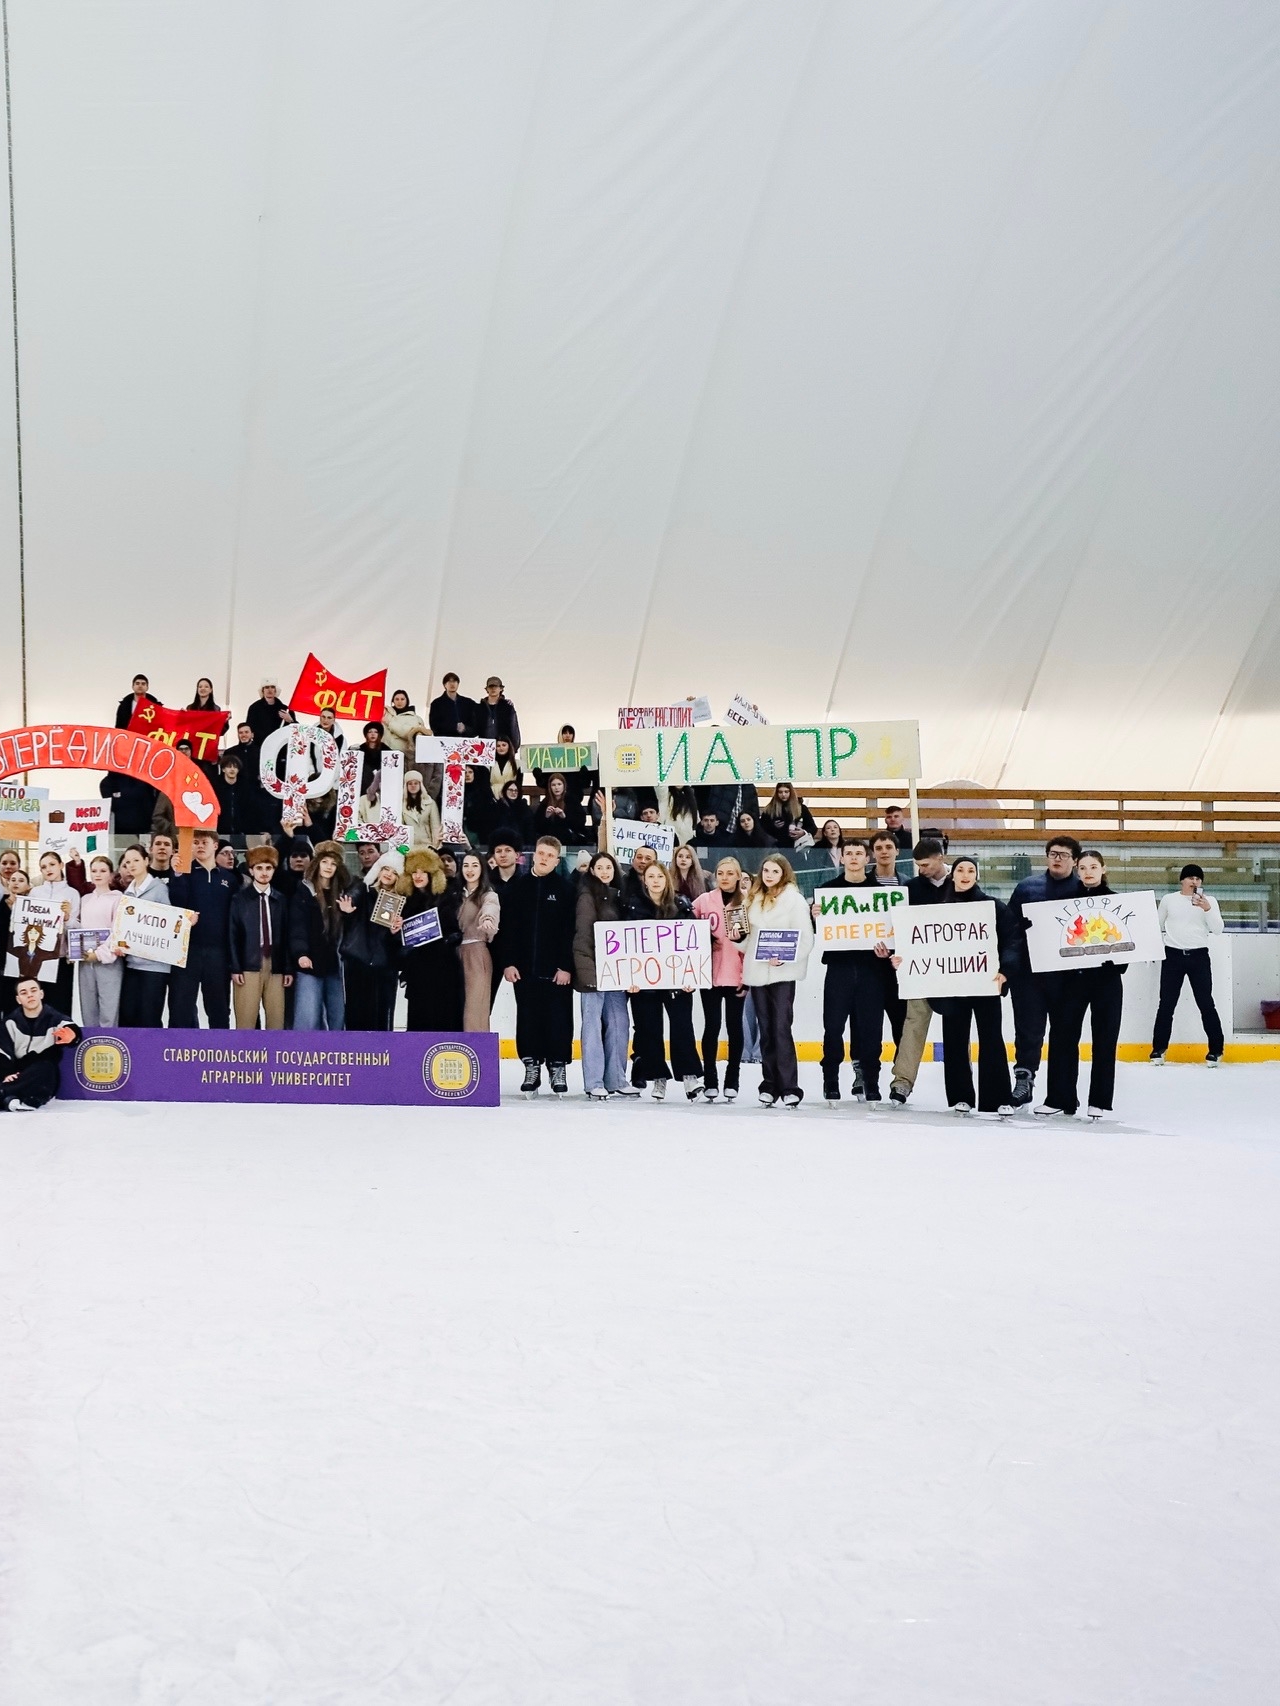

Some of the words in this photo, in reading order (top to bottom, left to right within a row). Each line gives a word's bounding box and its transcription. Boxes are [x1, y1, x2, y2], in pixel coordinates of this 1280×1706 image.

[313, 690, 383, 720] ФЦТ
[618, 707, 654, 717] АГРОФАК
[527, 746, 589, 769] ИАиПР
[656, 727, 859, 784] ИАиПР
[75, 806, 101, 818] ИСПО
[626, 831, 636, 840] НЕ
[638, 832, 668, 846] СКРОЕТ
[821, 891, 905, 916] ИАиПР
[1055, 897, 1136, 926] АГРОФАК
[21, 916, 29, 925] ЗА
[137, 913, 167, 929] ИСПО
[124, 930, 170, 950] ЛУЧШИЕ!
[605, 921, 699, 955] ВПЕРЁД
[911, 922, 989, 945] АГРОФАК
[600, 954, 711, 988] АГРОФАК
[909, 951, 988, 975] ЛУЧШИЙ
[163, 1047, 268, 1064] СТАВРОПОЛЬСКИЙ
[275, 1049, 391, 1067] ГОСУДАРСТВЕННЫЙ
[201, 1068, 263, 1085] АГРАРНЫЙ
[270, 1071, 352, 1087] УНИВЕРСИТЕТ
